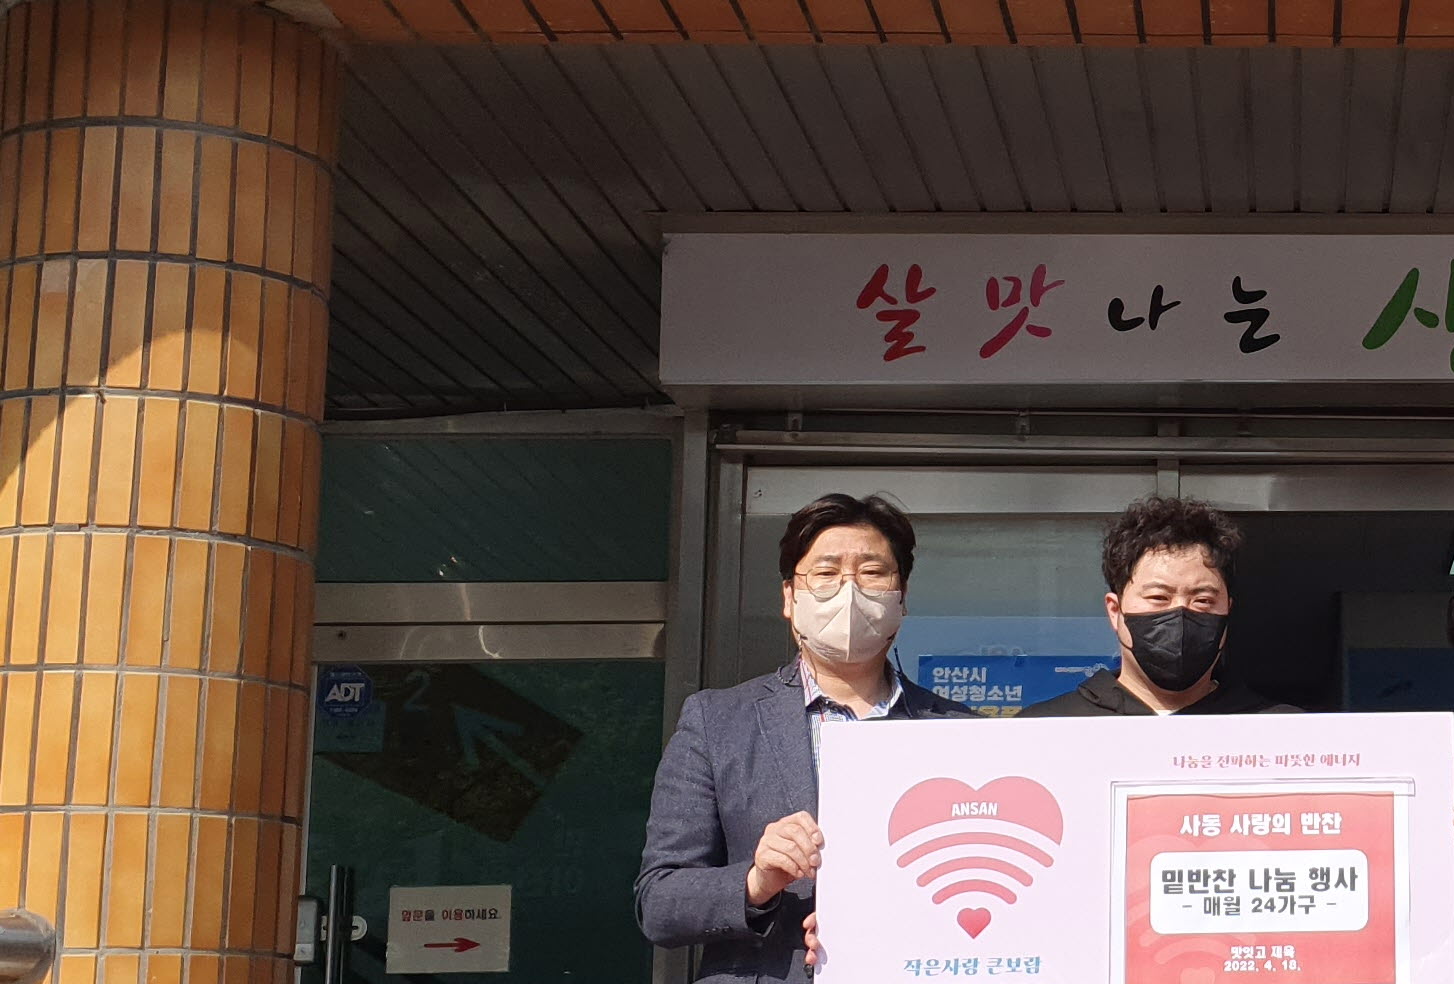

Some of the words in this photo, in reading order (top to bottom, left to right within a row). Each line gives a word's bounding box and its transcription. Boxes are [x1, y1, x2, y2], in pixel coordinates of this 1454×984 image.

[932, 667, 987, 683] 안산시
[325, 683, 365, 702] ADT
[932, 685, 1023, 702] 여성청소년
[1173, 755, 1212, 768] 나눔을
[1275, 753, 1316, 767] 따뜻한
[1320, 753, 1361, 766] 에너지
[951, 802, 998, 817] ANSAN
[1180, 814, 1222, 837] 사동
[1230, 813, 1291, 836] 사랑의
[1301, 812, 1343, 835] 반찬
[1161, 869, 1237, 895] 밑반찬
[1248, 867, 1297, 893] 나눔
[1308, 866, 1359, 892] 행사
[1203, 896, 1241, 916] 매월
[1251, 895, 1317, 915] 24가구
[401, 909, 435, 922] 옆문을
[903, 957, 980, 977] 작은사랑
[986, 956, 1042, 976] 큰보람
[1223, 960, 1260, 972] 2022.
[1263, 960, 1277, 972] 4.
[1281, 959, 1301, 972] 18.
